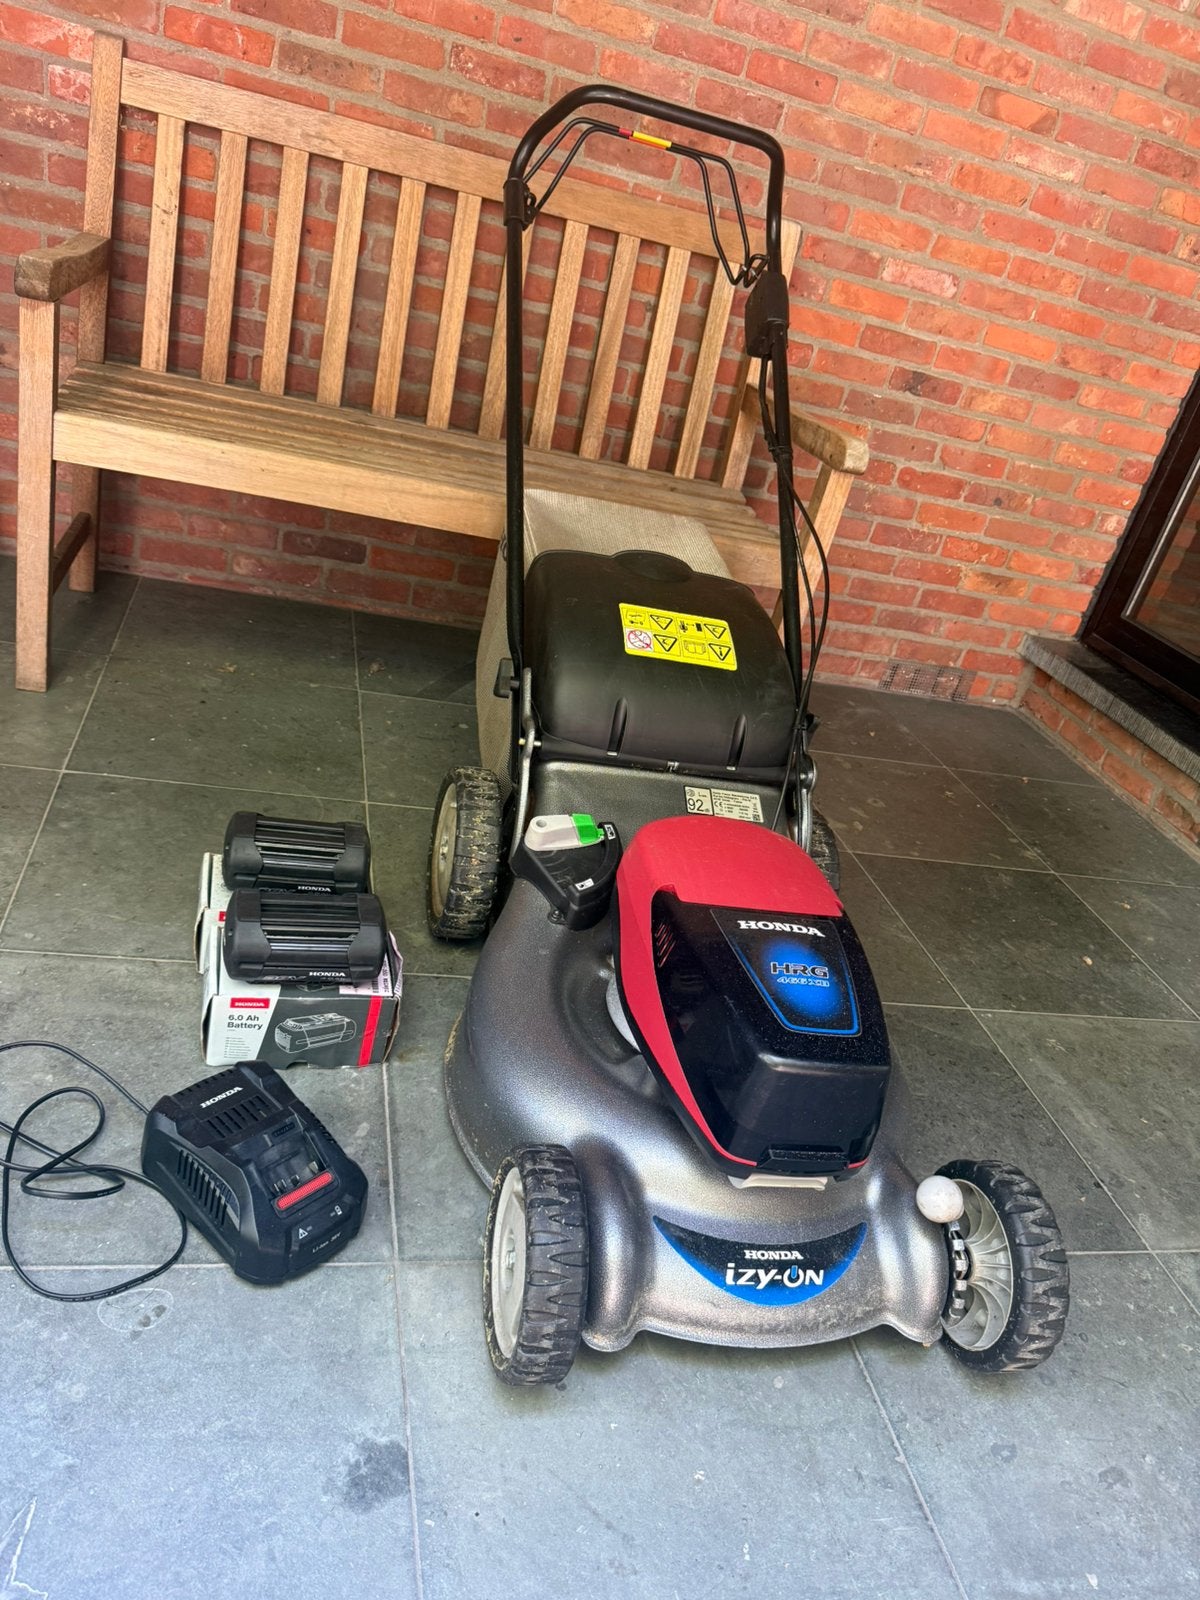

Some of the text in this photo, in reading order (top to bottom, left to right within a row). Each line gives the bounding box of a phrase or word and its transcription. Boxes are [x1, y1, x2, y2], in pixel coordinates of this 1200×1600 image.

[687, 797, 705, 812] 92
[737, 920, 826, 938] HONDA
[770, 961, 829, 979] HRG
[777, 976, 830, 988] 466XB
[227, 1021, 263, 1030] Battery
[199, 1086, 244, 1108] HONDA
[743, 1249, 804, 1260] HONDA
